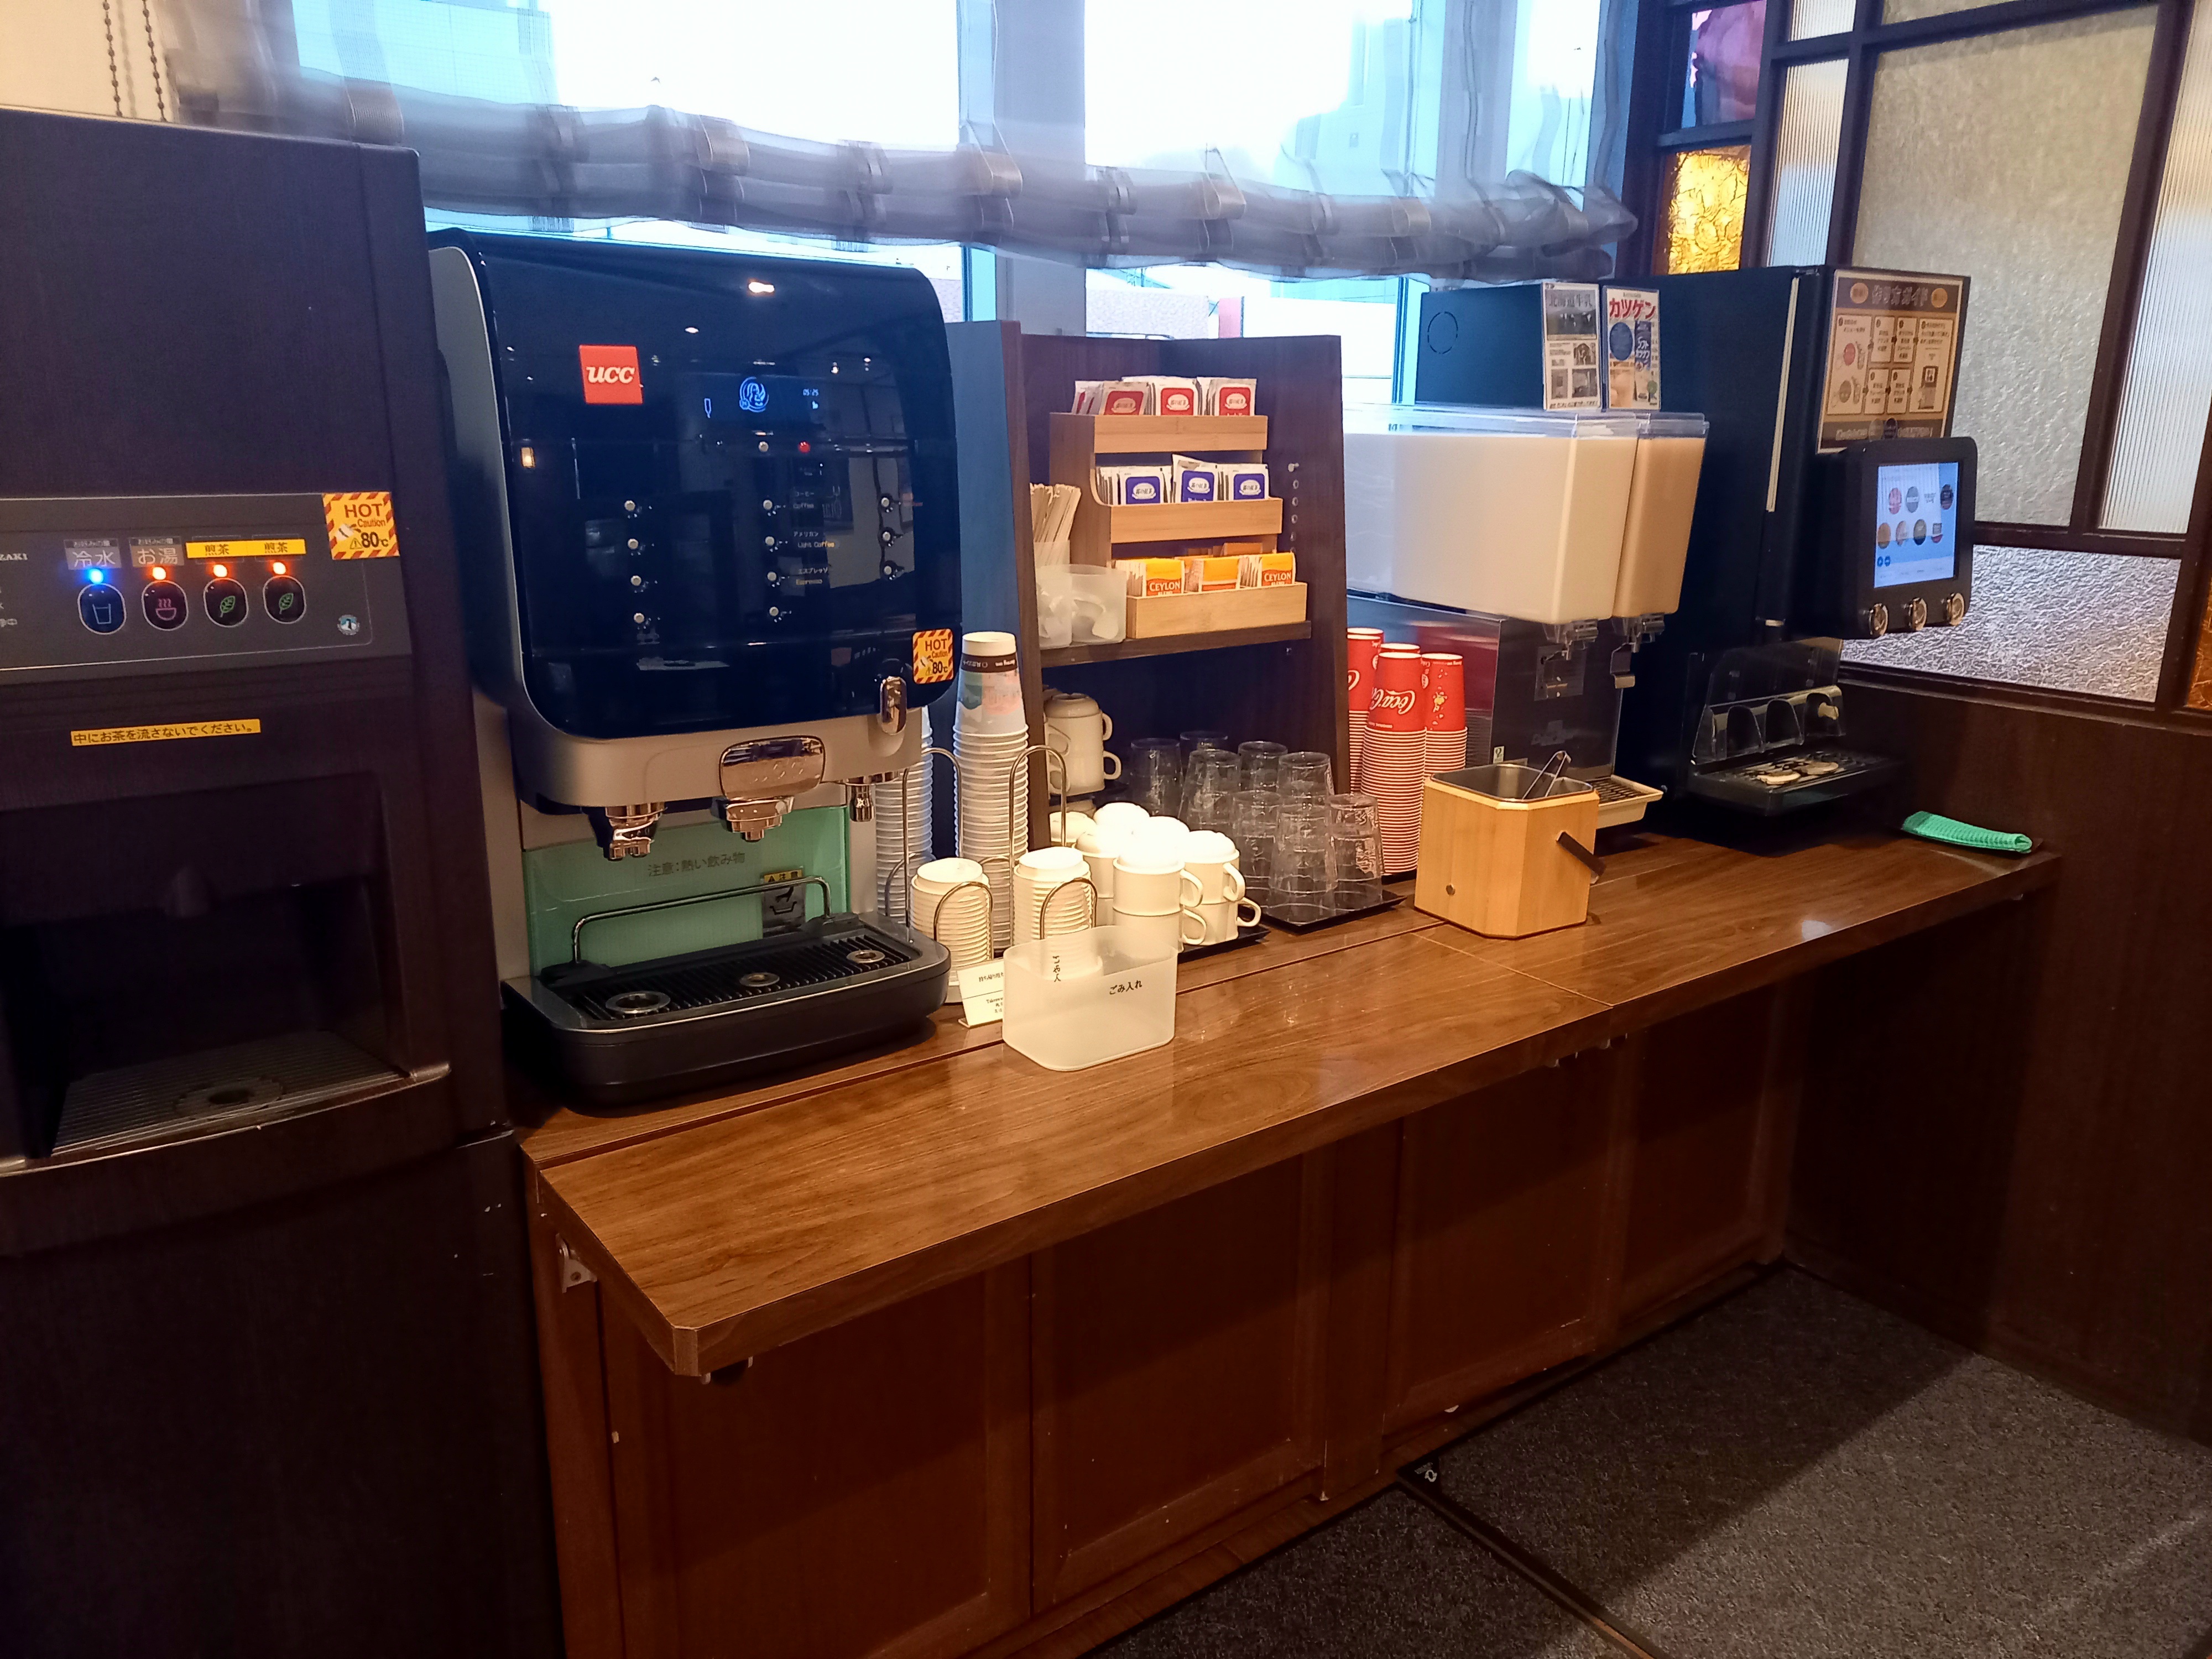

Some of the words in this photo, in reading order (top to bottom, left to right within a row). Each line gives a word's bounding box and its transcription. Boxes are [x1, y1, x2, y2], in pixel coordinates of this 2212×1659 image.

[1609, 298, 1656, 320] カツゲン
[345, 503, 383, 518] HOT
[357, 518, 386, 528] Caution
[205, 544, 230, 556] 煎茶
[264, 542, 288, 554] 煎茶
[72, 550, 116, 567] 冷水
[138, 547, 178, 565] お湯
[1264, 572, 1291, 582] CEYLON
[1149, 581, 1181, 592] CEYLON
[925, 638, 948, 651] HOT
[74, 723, 252, 744] 中にお茶を流さないでください。
[1109, 980, 1142, 995] ごみ入れ
